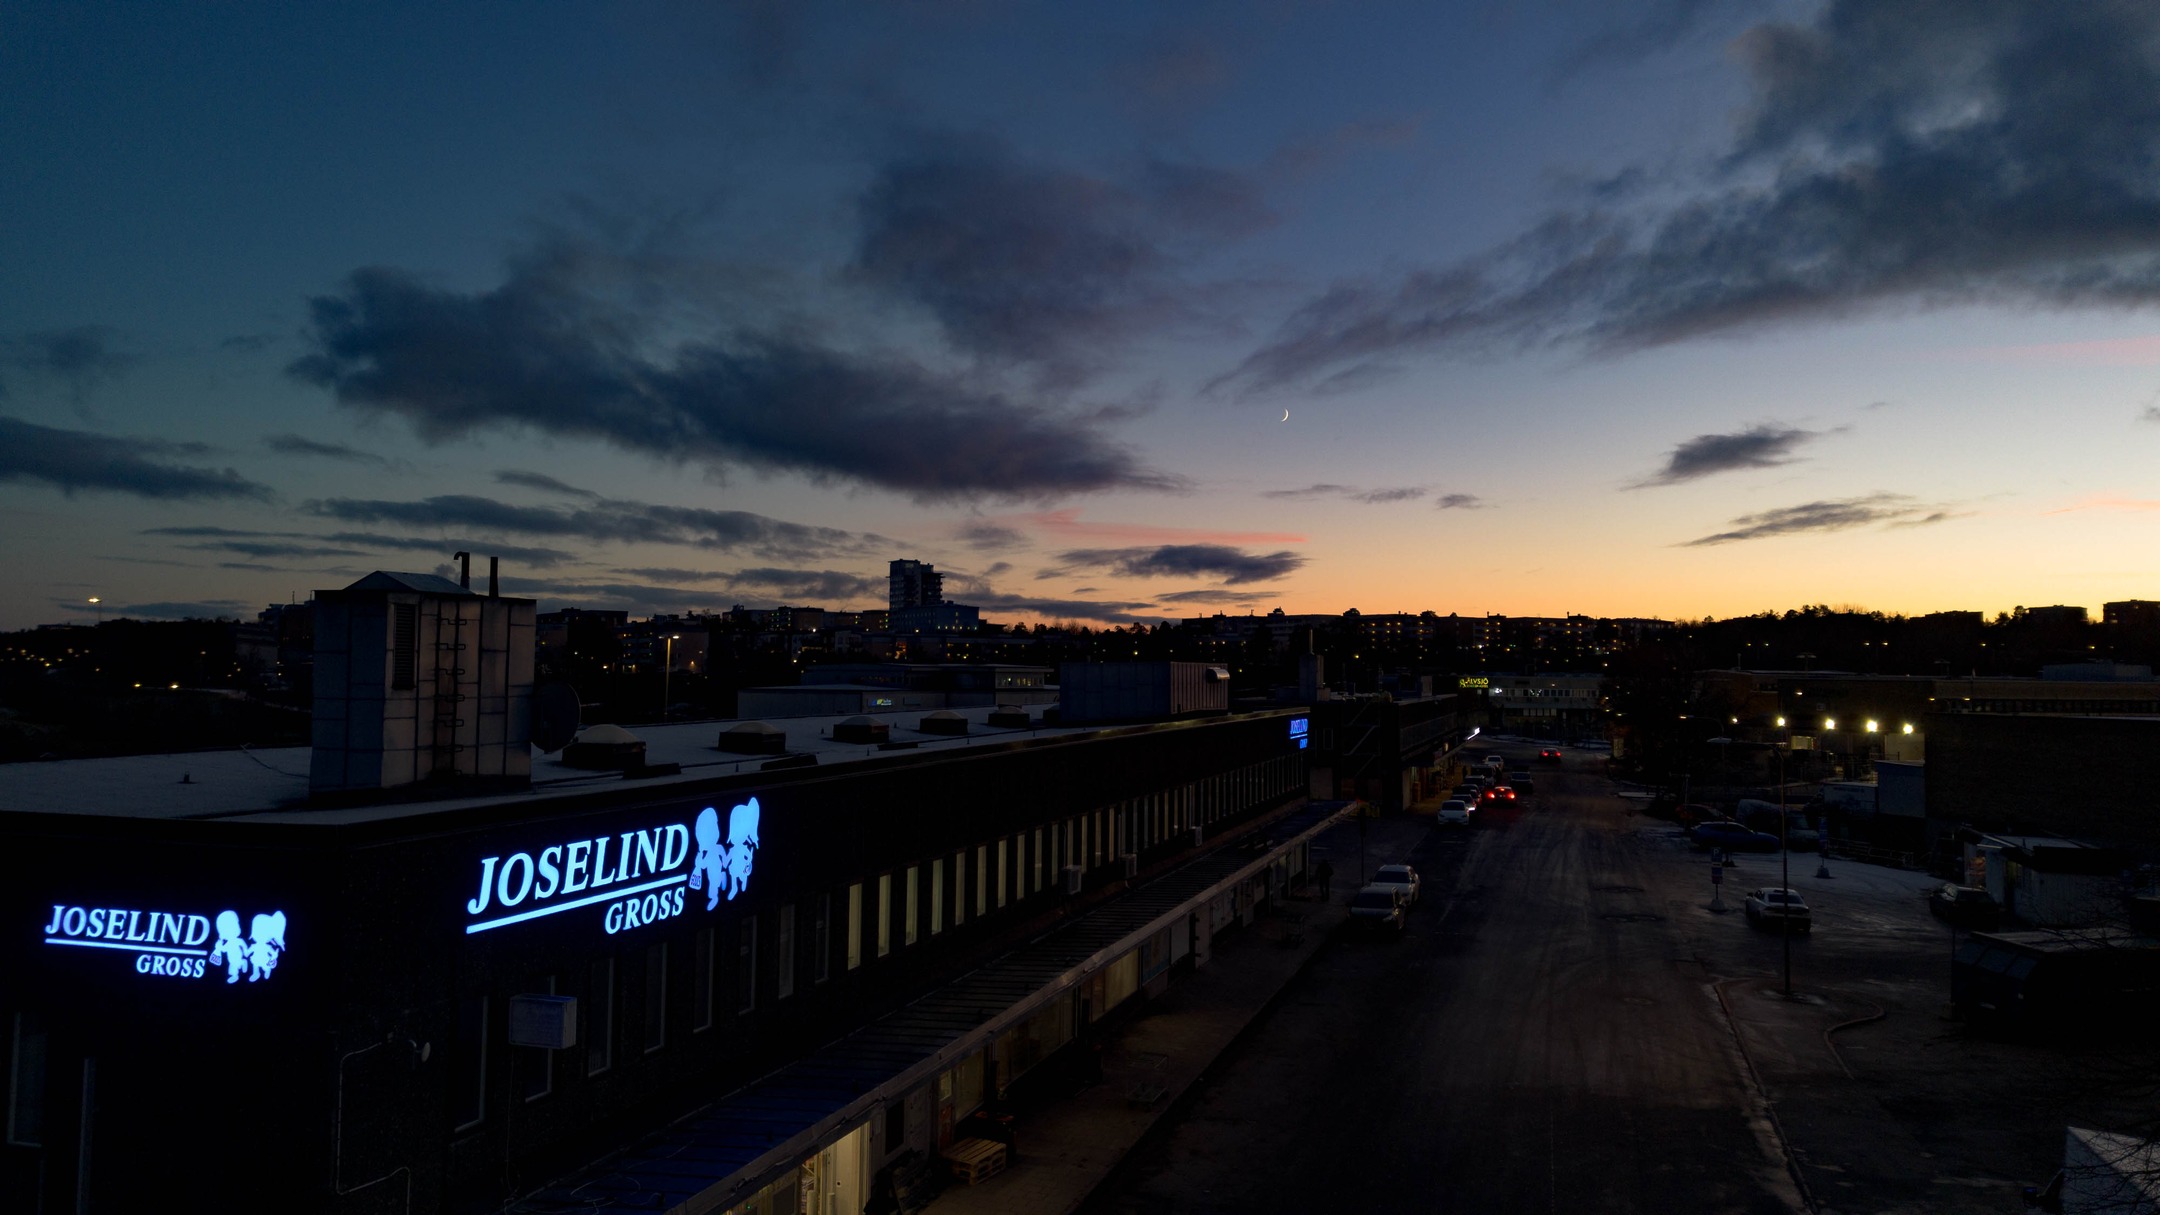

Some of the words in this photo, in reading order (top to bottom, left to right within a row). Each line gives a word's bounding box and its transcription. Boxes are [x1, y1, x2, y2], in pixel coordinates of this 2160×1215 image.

[467, 823, 689, 915] JOSELIND
[45, 905, 210, 946] JOSELIND
[604, 886, 685, 934] GROSS
[136, 954, 206, 978] GROSS
